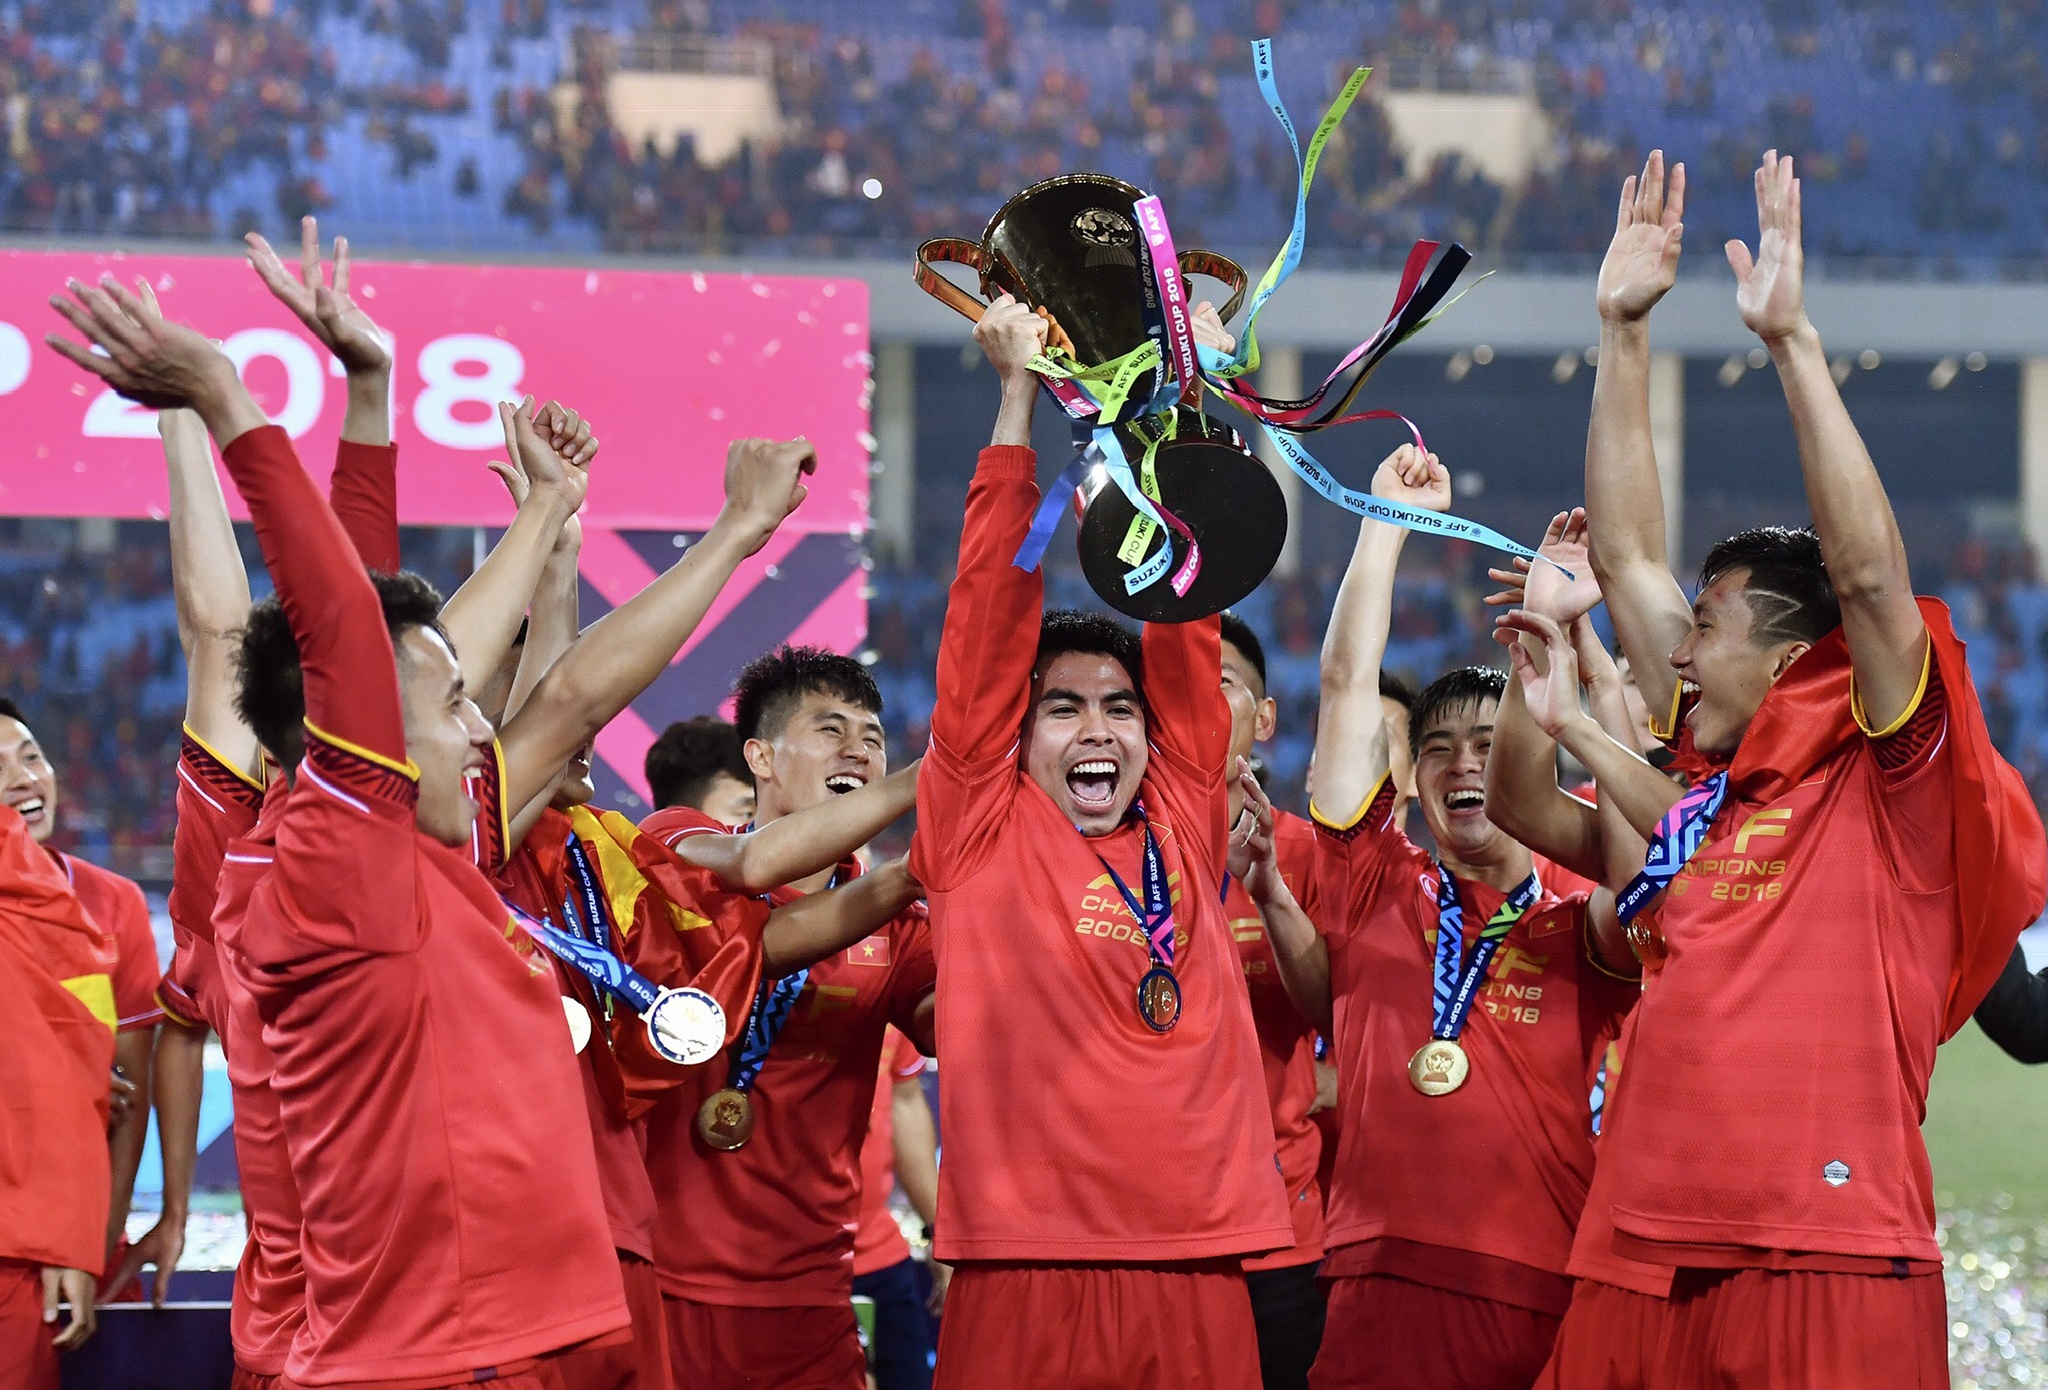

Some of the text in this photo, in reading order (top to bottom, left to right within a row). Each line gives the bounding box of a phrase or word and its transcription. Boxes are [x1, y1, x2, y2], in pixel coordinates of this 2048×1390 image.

[1142, 265, 1153, 287] CUP
[1145, 206, 1194, 379] SUZUKI CUP 2018 AFF
[1145, 286, 1156, 309] 2018
[1117, 369, 1131, 389] AFF
[1278, 435, 1298, 458] CUP
[1294, 455, 1320, 481] SUZUKI
[1143, 471, 1154, 496] 018
[1343, 494, 1366, 510] 2018
[1367, 504, 1391, 516] CUP
[1136, 514, 1149, 540] ZUKI
[1391, 509, 1443, 528] SUZUKI
[1444, 523, 1470, 533] AFF
[1129, 552, 1169, 588] SUZUKI
[1147, 847, 1159, 882] SUZUKI
[573, 848, 604, 946] AFF SUZUKI CUP 2018
[1151, 883, 1162, 901] AFF
[1627, 881, 1650, 906] 2018
[1710, 881, 1783, 902] 2018
[569, 917, 581, 939] CUP
[1074, 917, 1148, 947] 2008
[548, 938, 602, 978] CUP 2018
[628, 979, 656, 1005] 2018
[1442, 948, 1487, 1039] AFF SUZUKI CUP 20
